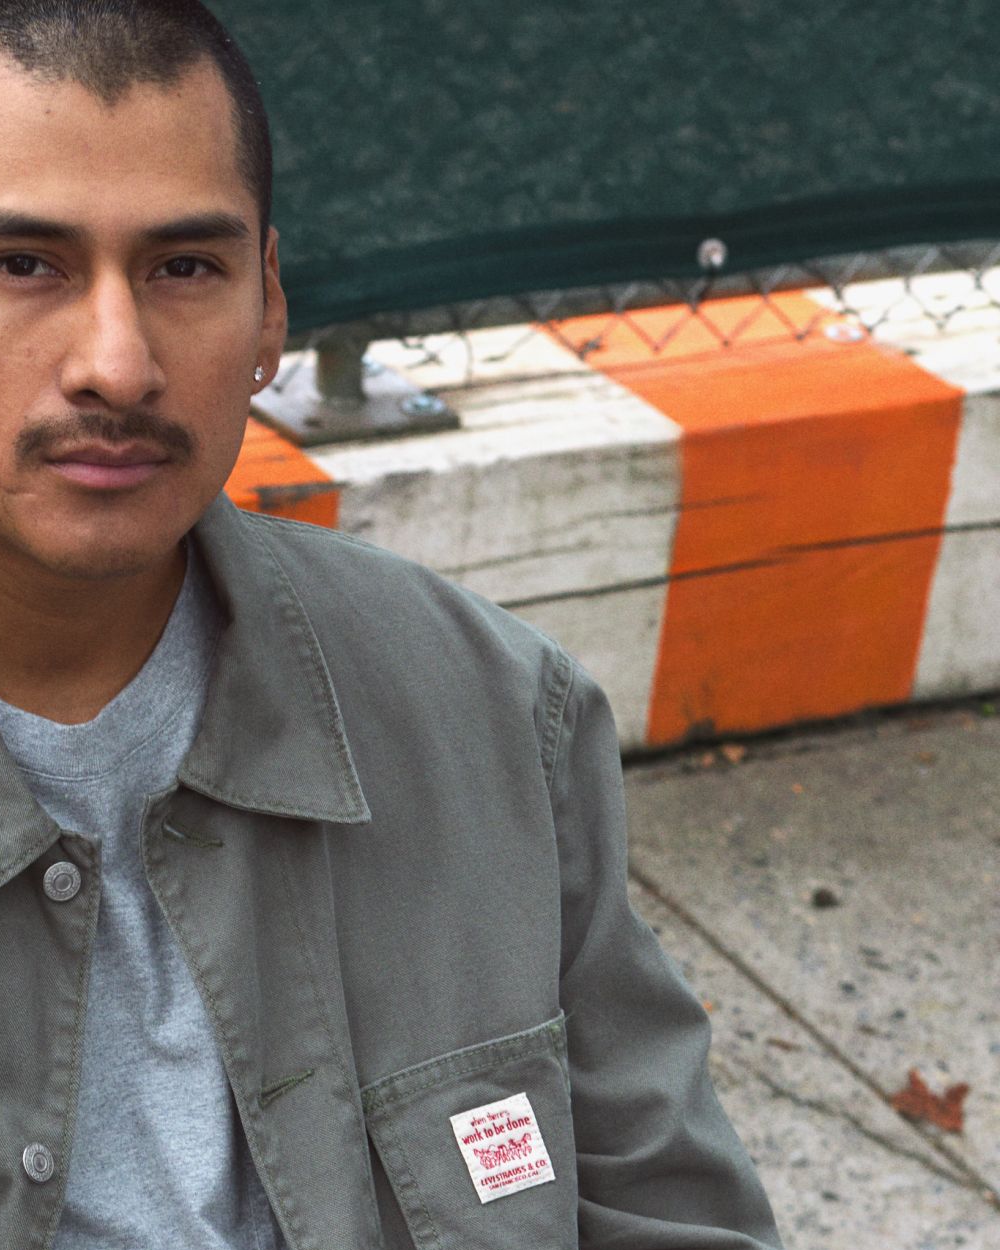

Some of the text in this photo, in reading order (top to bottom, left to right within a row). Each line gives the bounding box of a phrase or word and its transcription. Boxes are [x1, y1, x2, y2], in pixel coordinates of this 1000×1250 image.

[462, 1117, 531, 1145] work to be done
[480, 1176, 496, 1186] LEVI
[495, 1166, 527, 1180] STRAUSS
[527, 1163, 534, 1171] &
